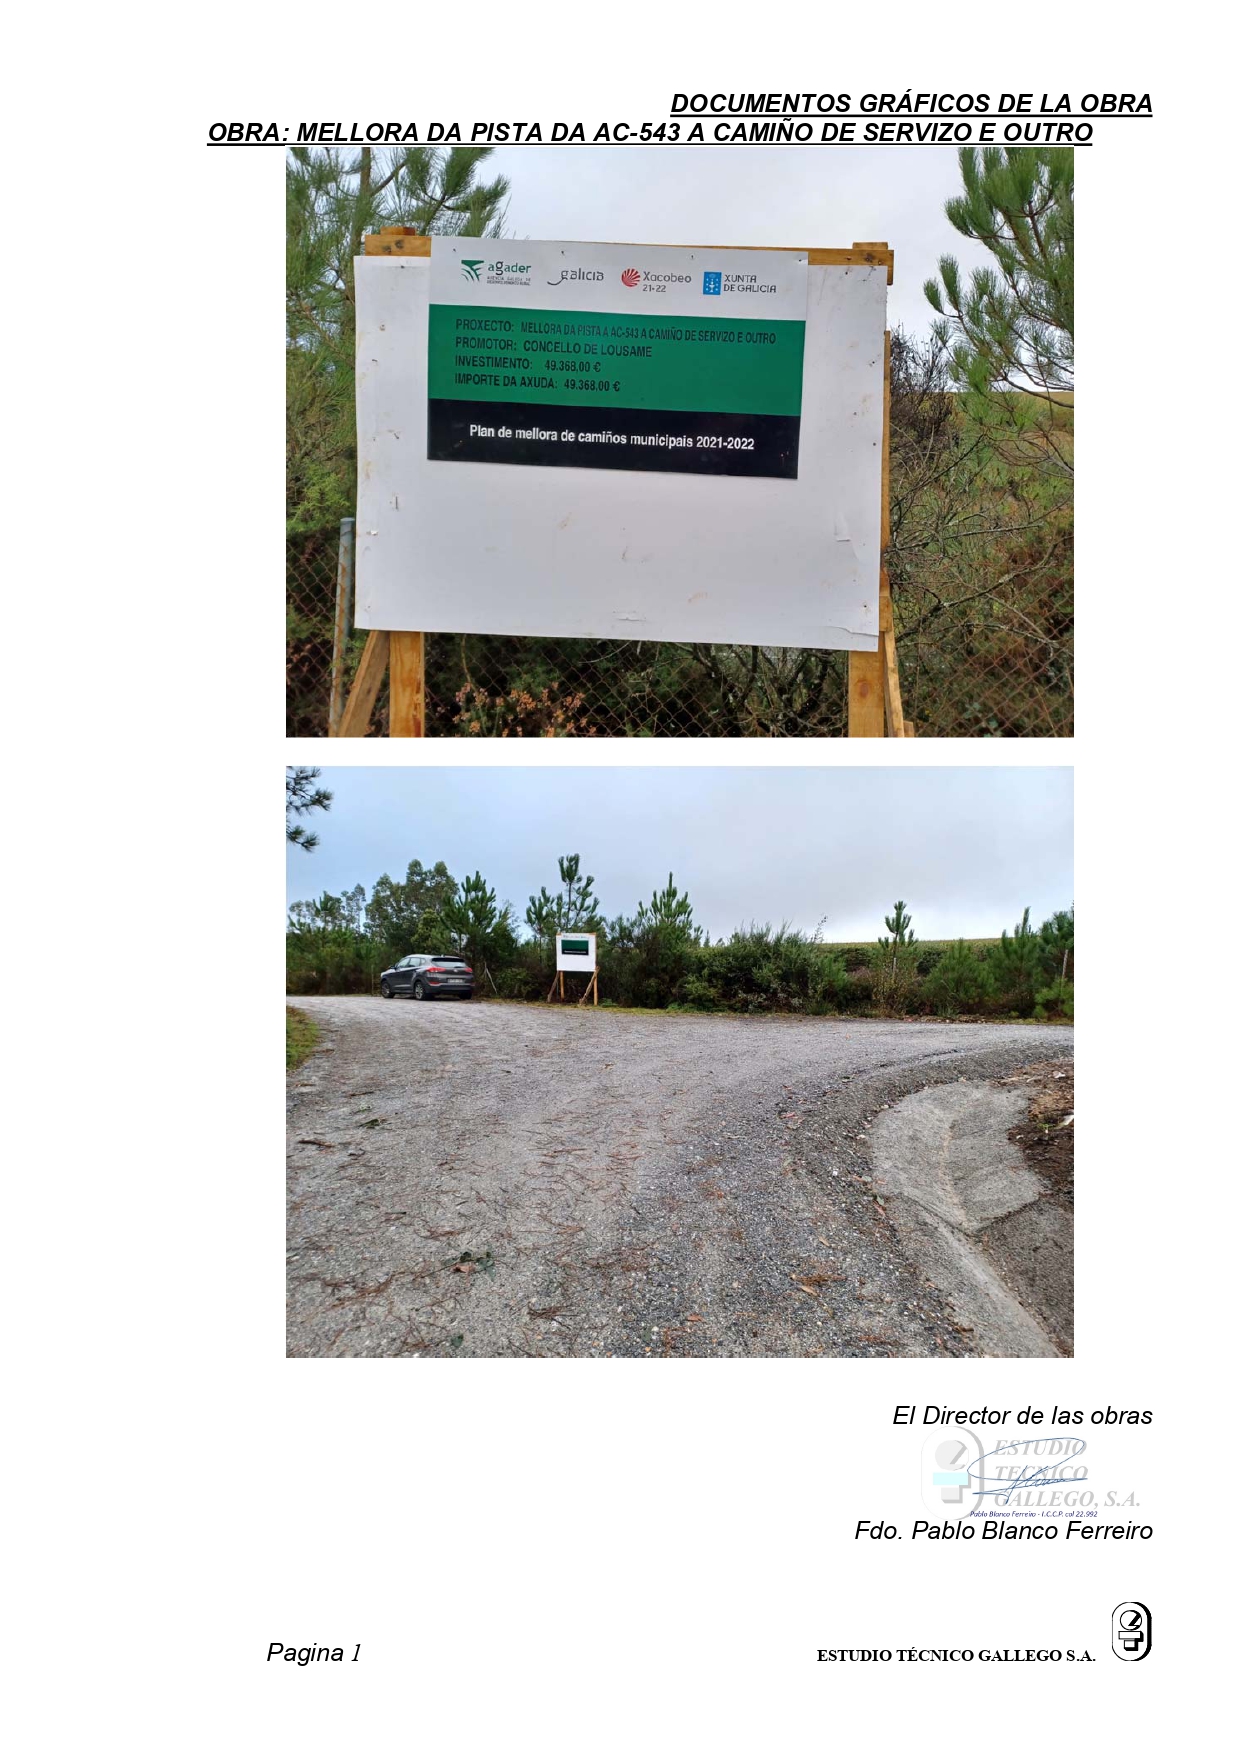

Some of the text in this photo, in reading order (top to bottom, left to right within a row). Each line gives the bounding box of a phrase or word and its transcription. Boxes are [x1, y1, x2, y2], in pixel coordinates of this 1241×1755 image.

[671, 89, 1153, 113] DOCUMENTOS GRÁFICOS DE LA OBRA
[208, 117, 1094, 142] OBRA: MELLORA DA PISTA DA AC-543 A CAMIÑO DE SERVIZO E OUTRO
[488, 261, 532, 276] agader
[643, 271, 692, 284] Xacobeo
[724, 274, 757, 283] XUNTA
[723, 284, 777, 294] DE GALICIA
[455, 318, 777, 345] PROXECTO: MELLORA DA PISTA A AC-543 A CAMIÑO DE SERVIZO E OUTRO
[455, 336, 652, 358] PROMOTOR: CONCELLO DE LOUSAME
[455, 355, 601, 373] INVESTIMENTO: 49.368,00 €
[455, 373, 620, 392] IMPORTE DA AXUDA: 49.368,00 €
[469, 424, 755, 450] Plan de mellora de camiños municipais 2021-2022
[892, 1405, 1154, 1425] El Director de las obras
[994, 1439, 1088, 1456] ESTUDIO
[993, 1490, 1141, 1509] GALLEGO, S.A.
[969, 1510, 988, 1518] Pablo
[989, 1510, 1010, 1518] Blanco
[1011, 1510, 1036, 1518] Ferreiro
[1076, 1510, 1098, 1518] 22.992
[854, 1520, 1154, 1540] Fdo. Pablo Blanco Ferreiro
[266, 1642, 361, 1667] Pagina 1
[816, 1646, 1096, 1662] ESTUDIO TÉCNICO GALLEGO S.A.
